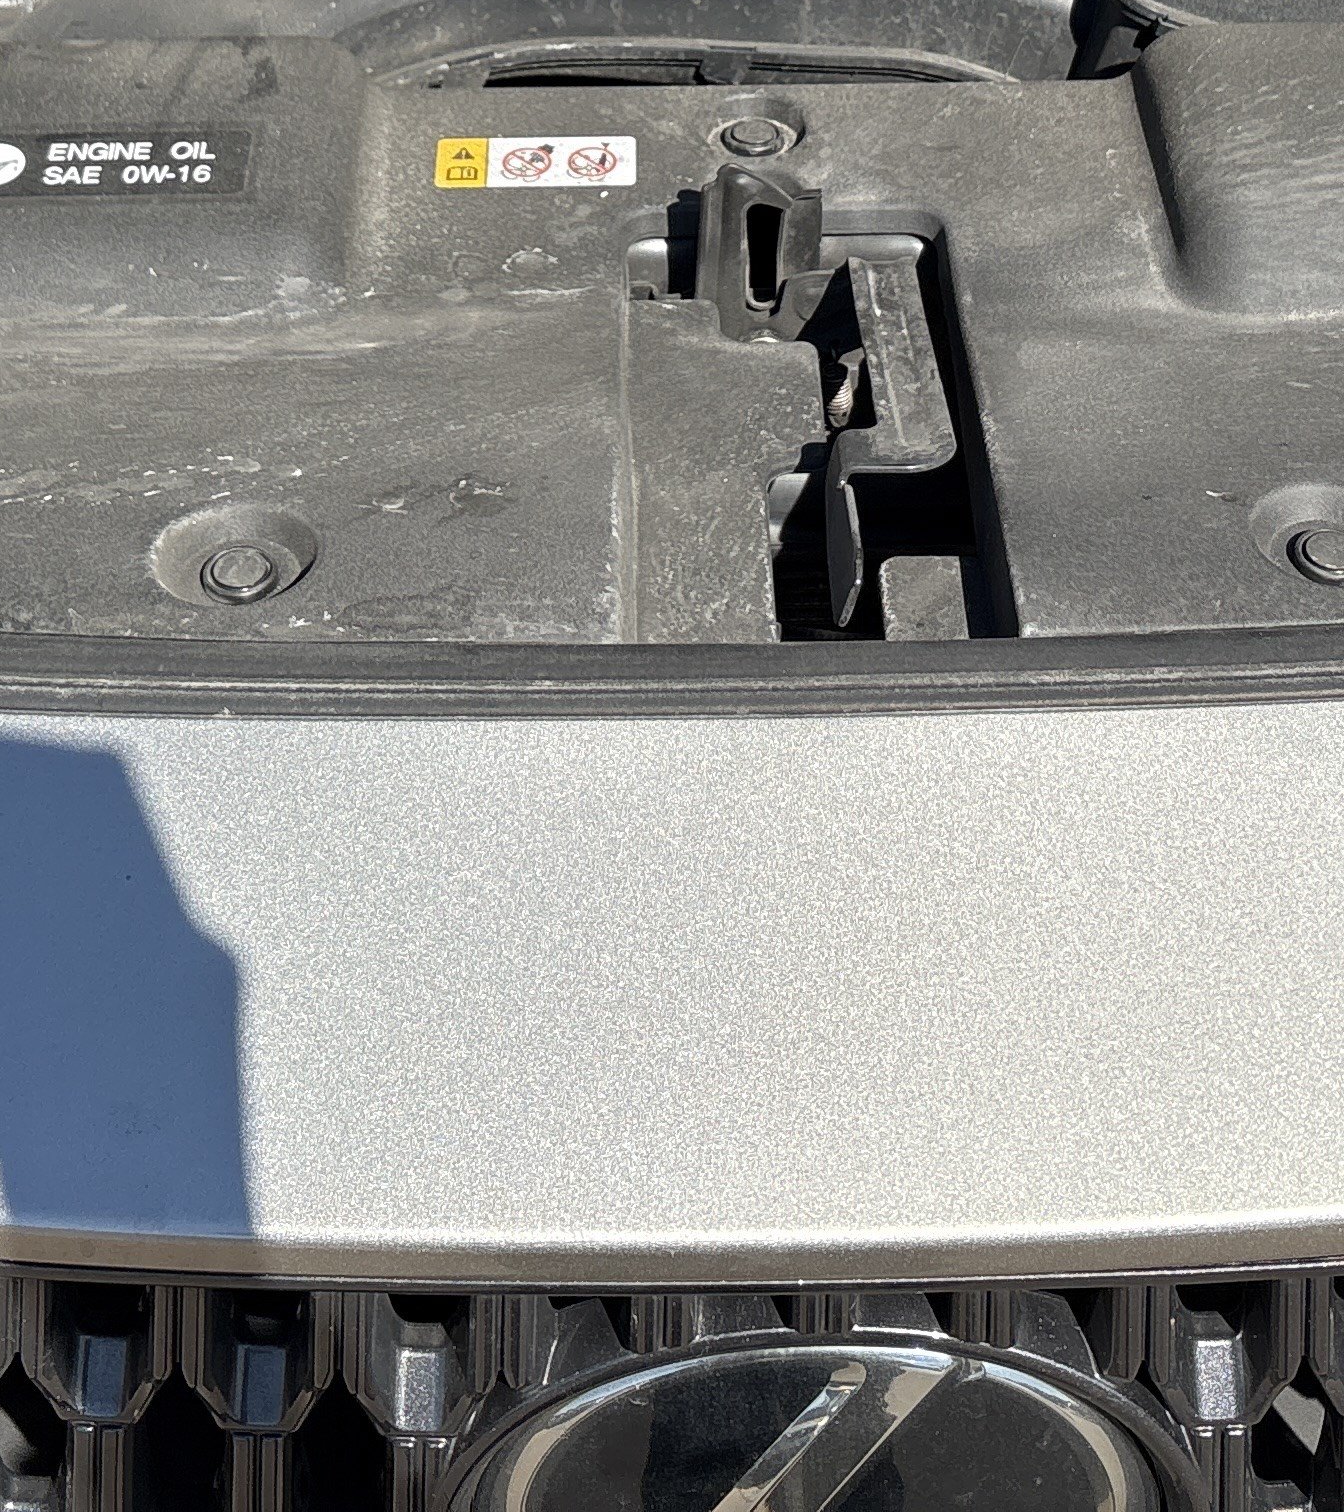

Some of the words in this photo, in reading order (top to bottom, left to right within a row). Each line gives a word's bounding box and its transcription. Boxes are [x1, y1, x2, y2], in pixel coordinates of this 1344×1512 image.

[46, 141, 153, 161] ENGINE
[170, 141, 216, 161] OIL
[42, 165, 102, 186] SAE
[121, 164, 212, 185] 0W-16
